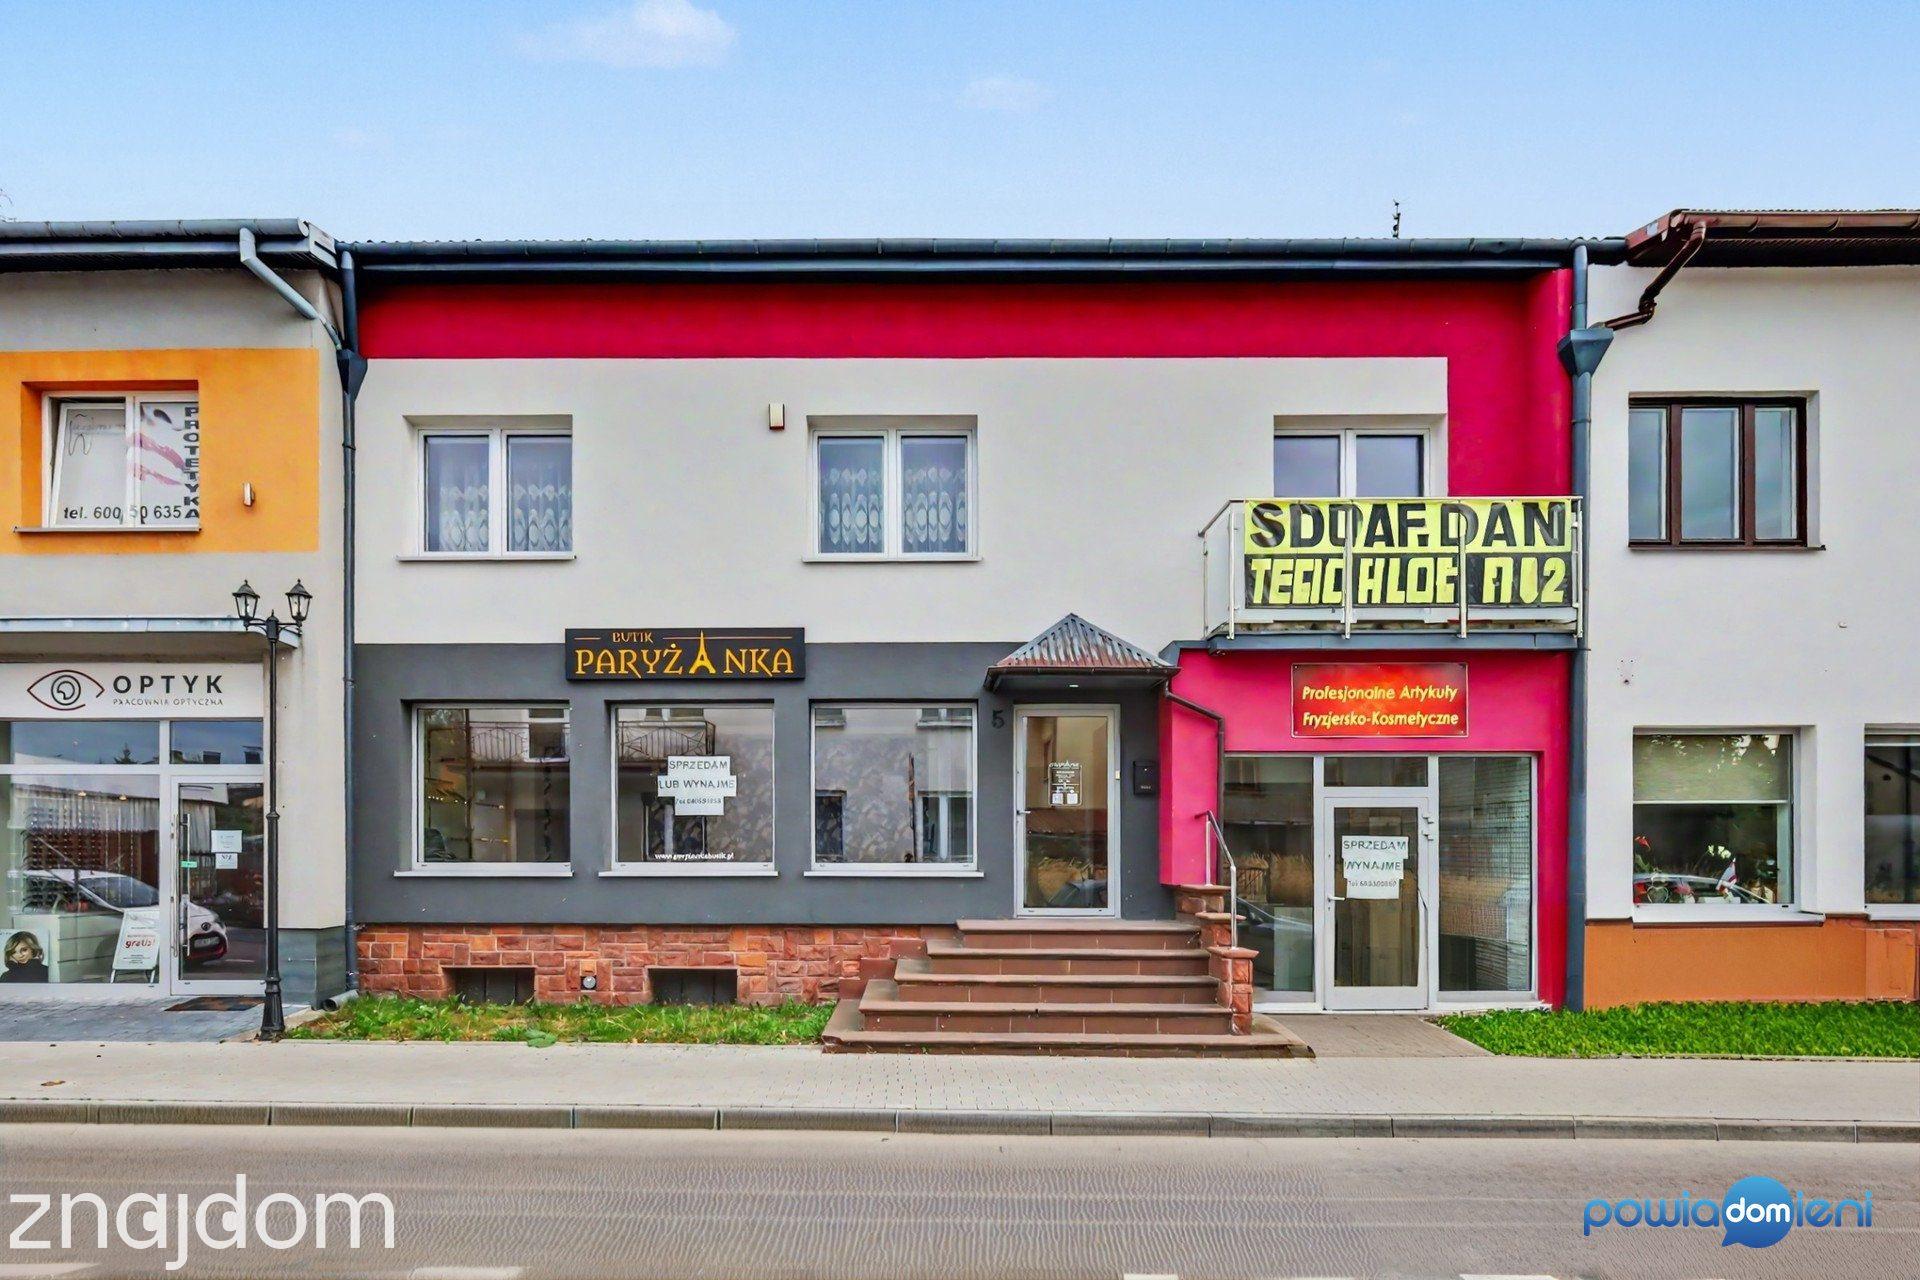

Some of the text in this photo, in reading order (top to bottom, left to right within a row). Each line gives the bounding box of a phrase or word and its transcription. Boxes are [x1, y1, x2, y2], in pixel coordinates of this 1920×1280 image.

[64, 506, 87, 519] tel.
[154, 506, 181, 519] 635
[612, 631, 654, 644] BUTIK
[113, 675, 223, 694] OPTYK
[1302, 685, 1458, 703] Profesjonalne Artykuły
[992, 710, 1005, 729] 5
[1302, 711, 1459, 729] Fryzjersko-Kosmetyczne
[669, 760, 728, 770] SPRZEDAM
[659, 780, 680, 789] LUB
[1343, 840, 1406, 850] SPRZEDAM
